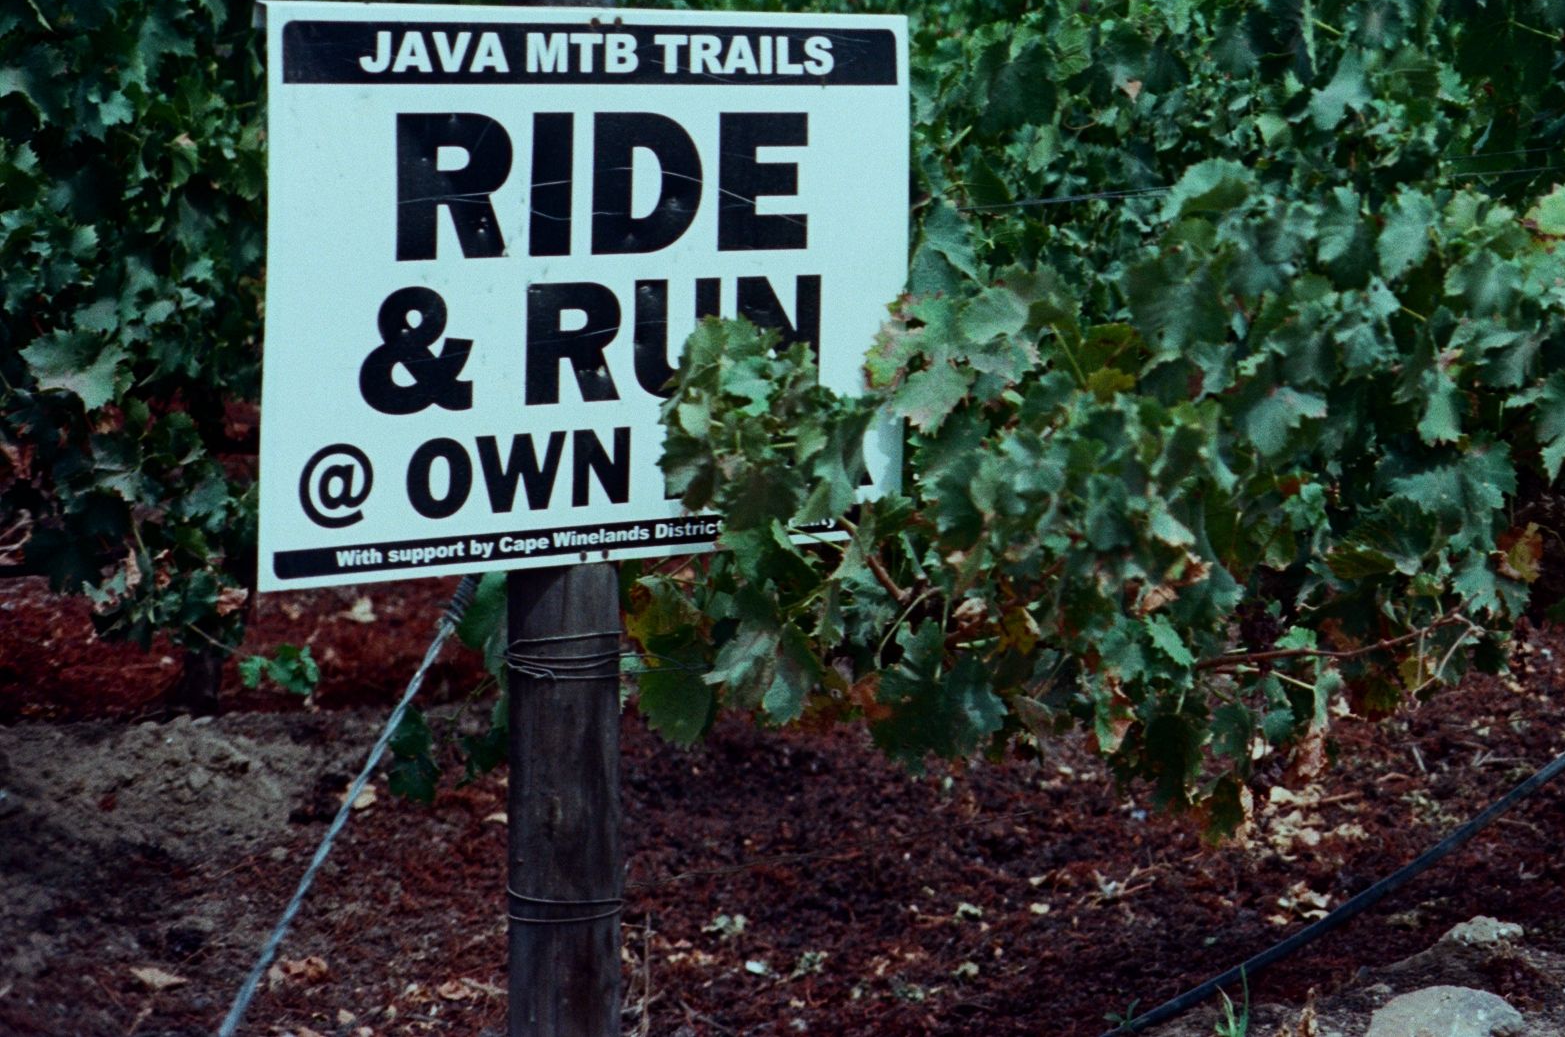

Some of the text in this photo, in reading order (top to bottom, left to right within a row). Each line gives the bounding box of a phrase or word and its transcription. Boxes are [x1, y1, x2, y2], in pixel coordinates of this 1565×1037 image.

[359, 31, 835, 75] JAVA MTB TRAILS
[395, 111, 809, 262] RIDE
[358, 274, 822, 416] & RUN
[299, 443, 374, 529] @
[405, 426, 632, 520] OWN
[336, 518, 724, 567] With support by Cape Winelands District
